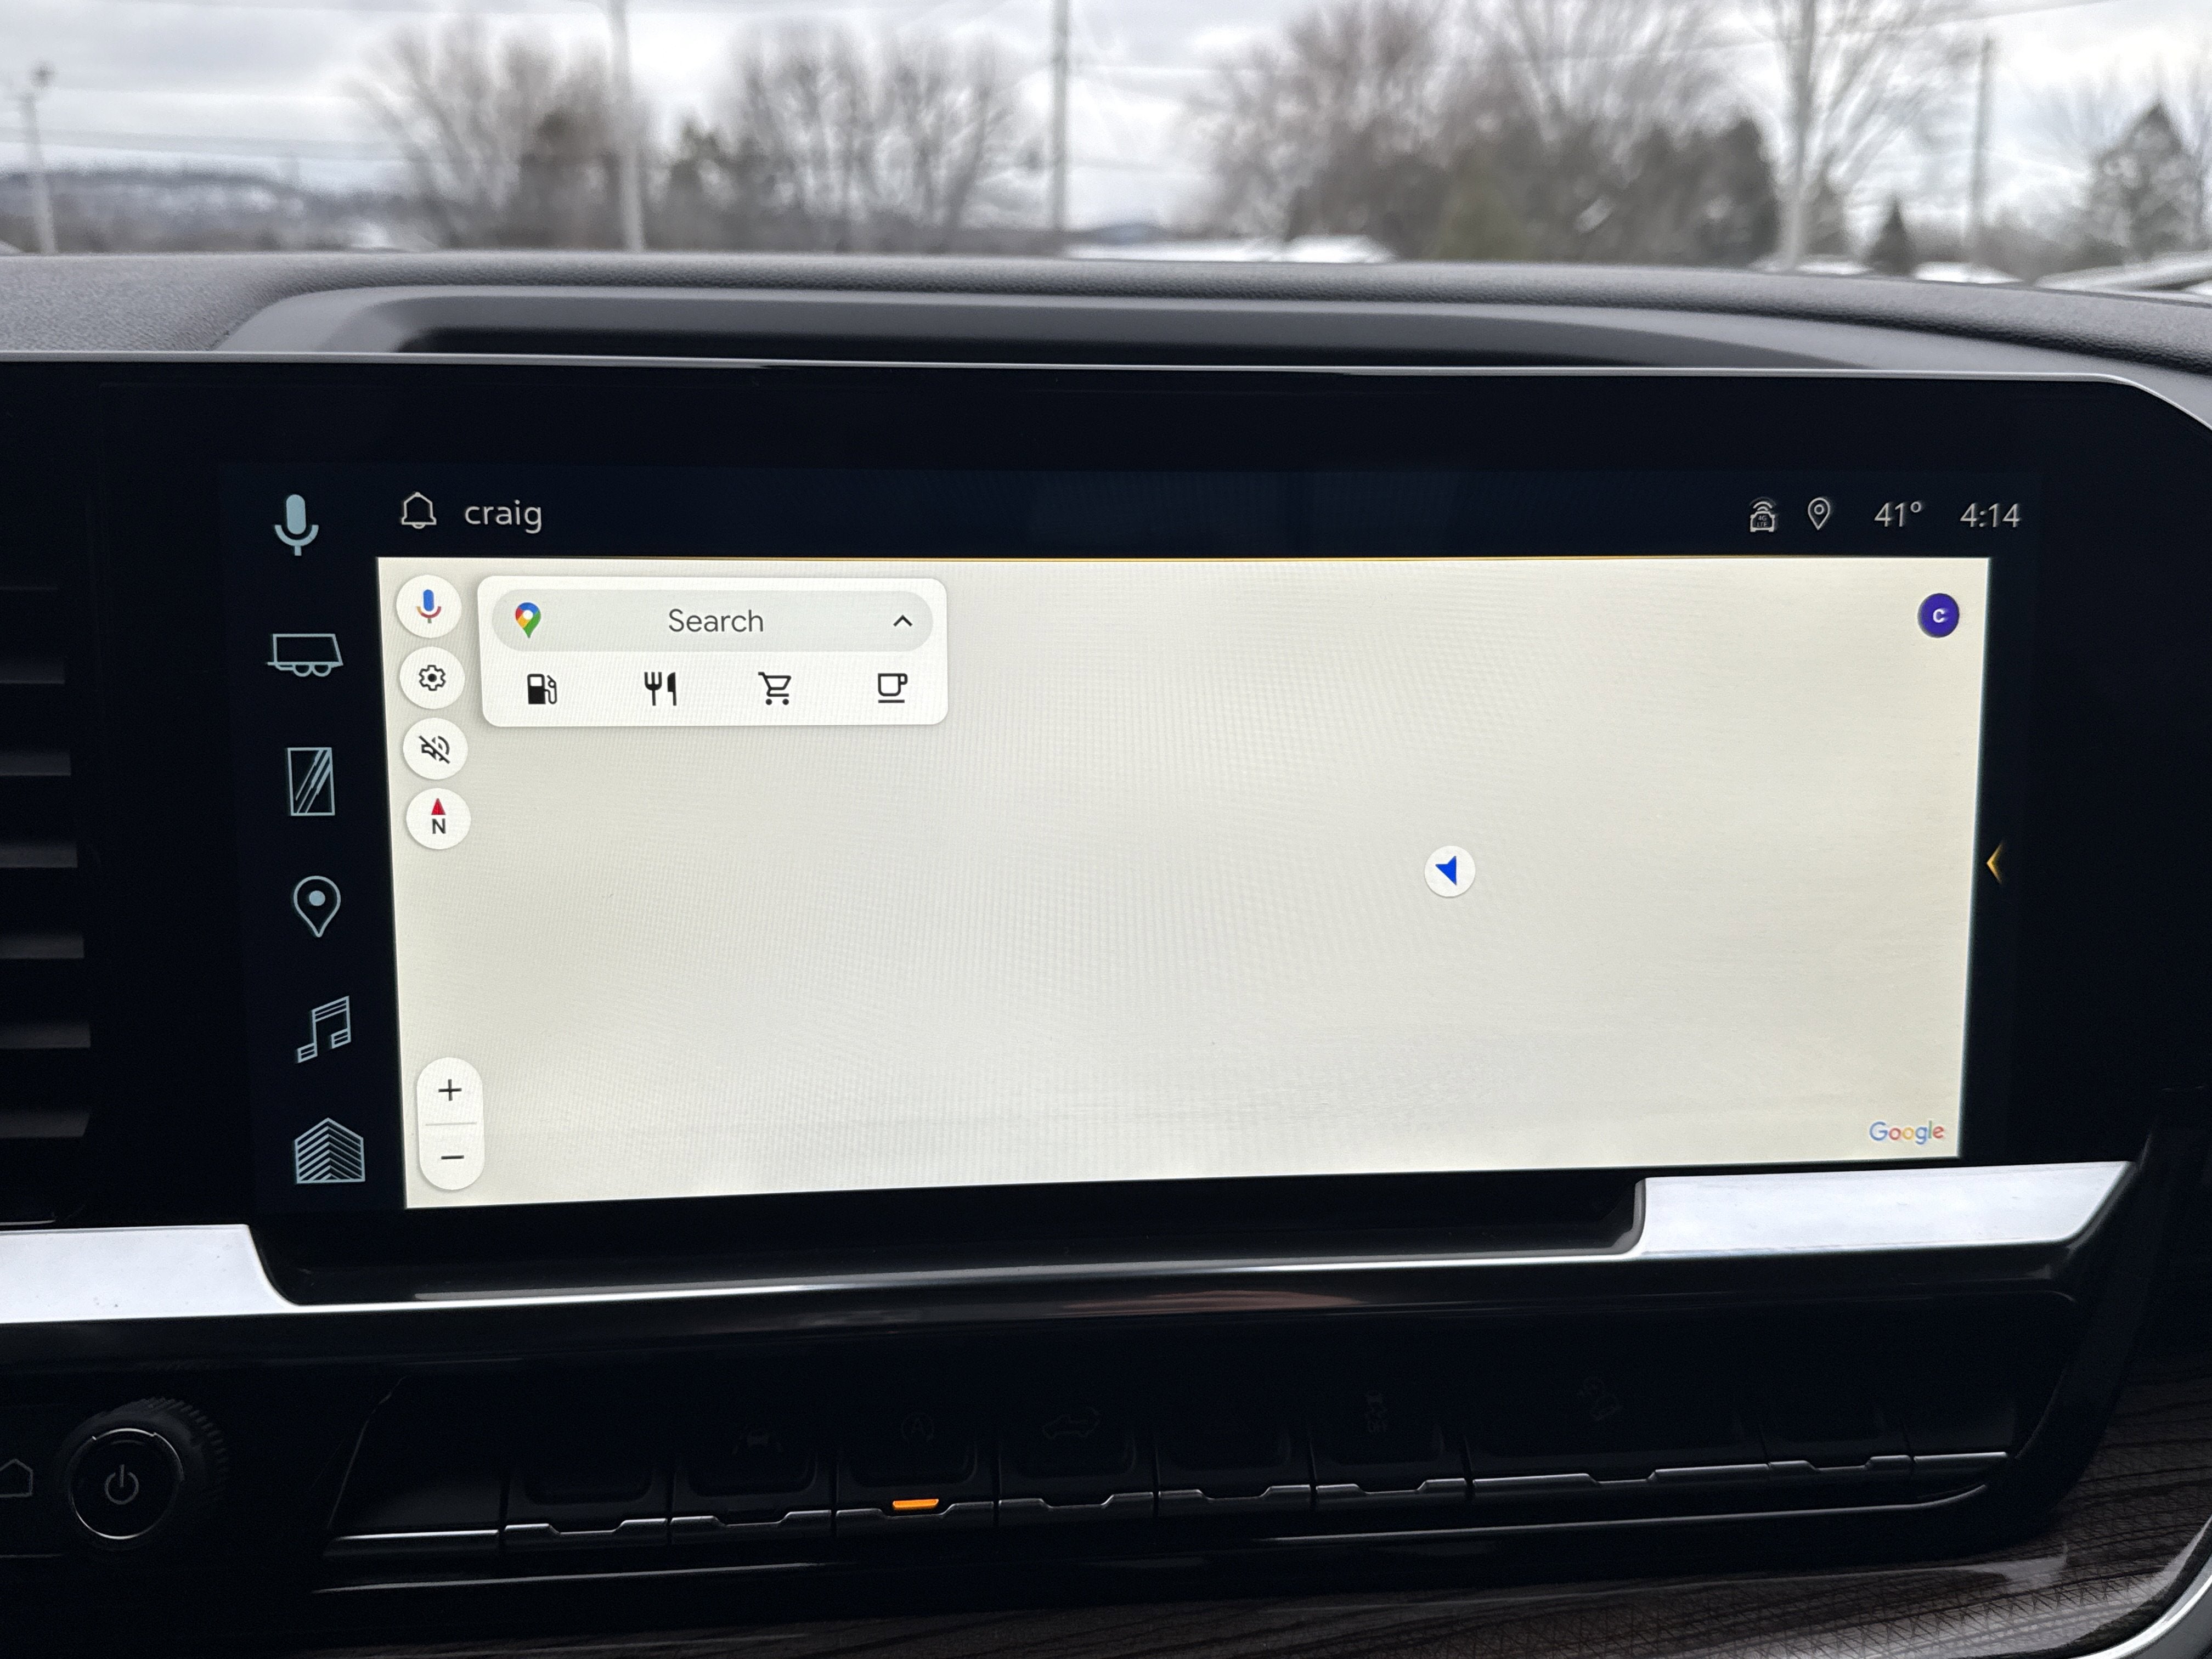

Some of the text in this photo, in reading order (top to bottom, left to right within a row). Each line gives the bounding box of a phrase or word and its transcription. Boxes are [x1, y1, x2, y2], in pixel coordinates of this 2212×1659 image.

[465, 500, 543, 534] craig
[1960, 502, 2022, 528] 4:14
[668, 608, 764, 632] Search
[431, 818, 447, 834] N
[1869, 1120, 1945, 1145] Google
